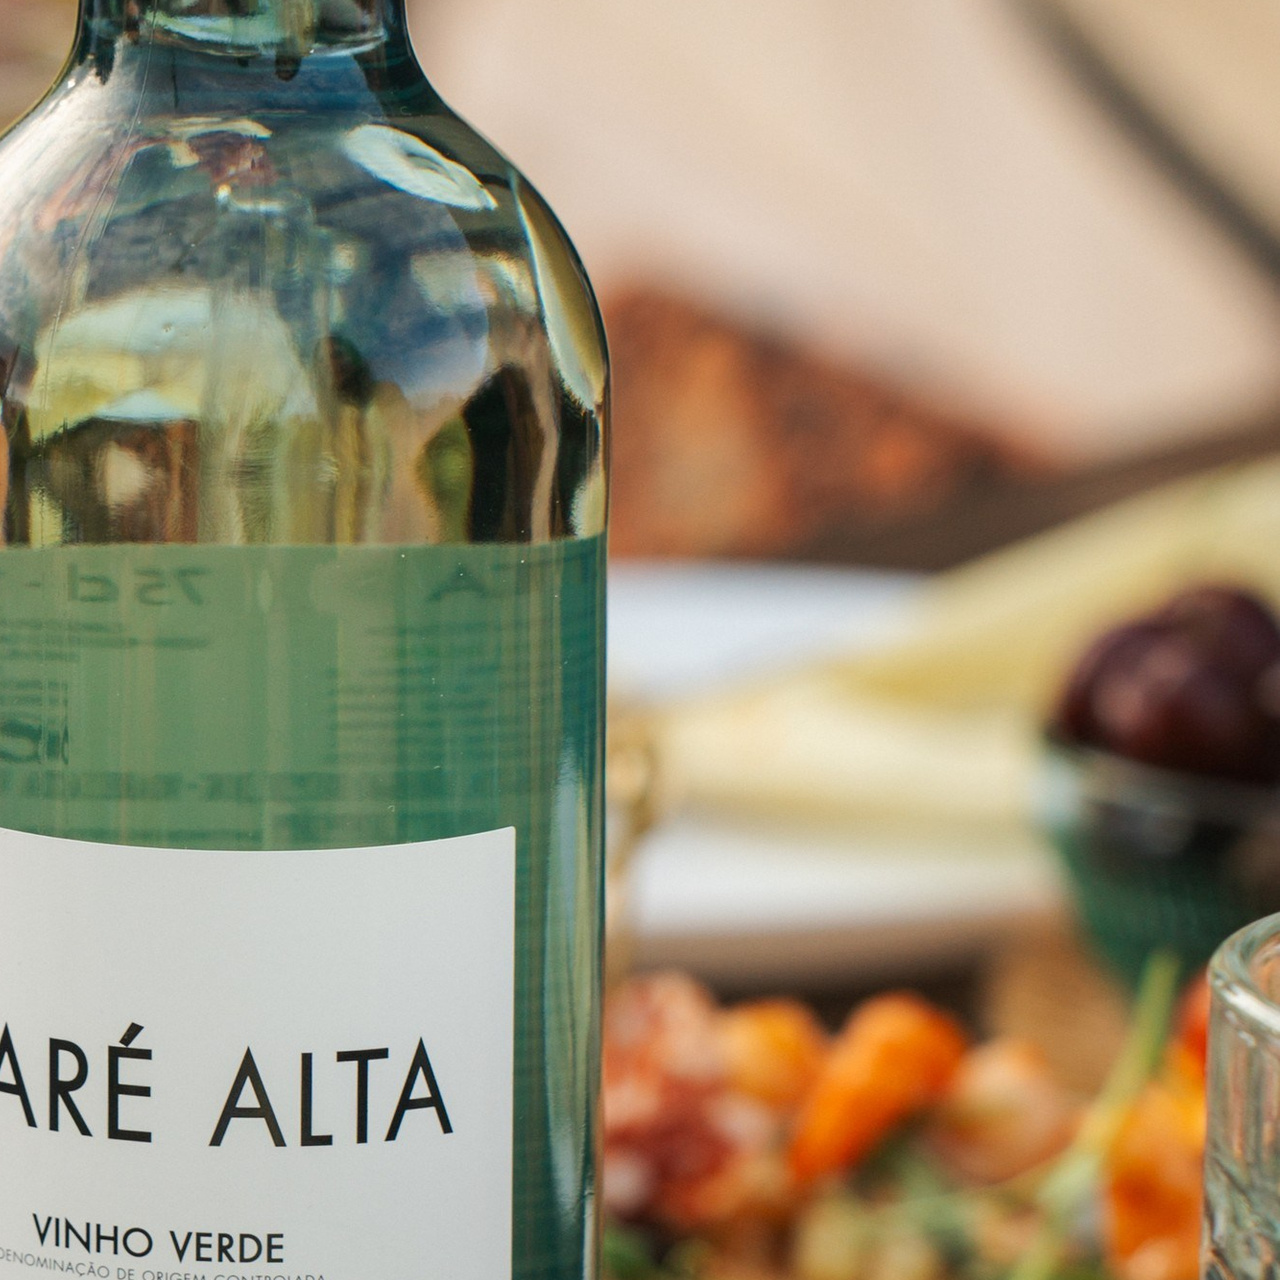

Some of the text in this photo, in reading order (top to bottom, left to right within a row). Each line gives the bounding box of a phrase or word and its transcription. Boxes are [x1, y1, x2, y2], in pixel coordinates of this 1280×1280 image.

[208, 1037, 454, 1148] ALTA
[32, 1213, 284, 1263] VINHO VERDE
